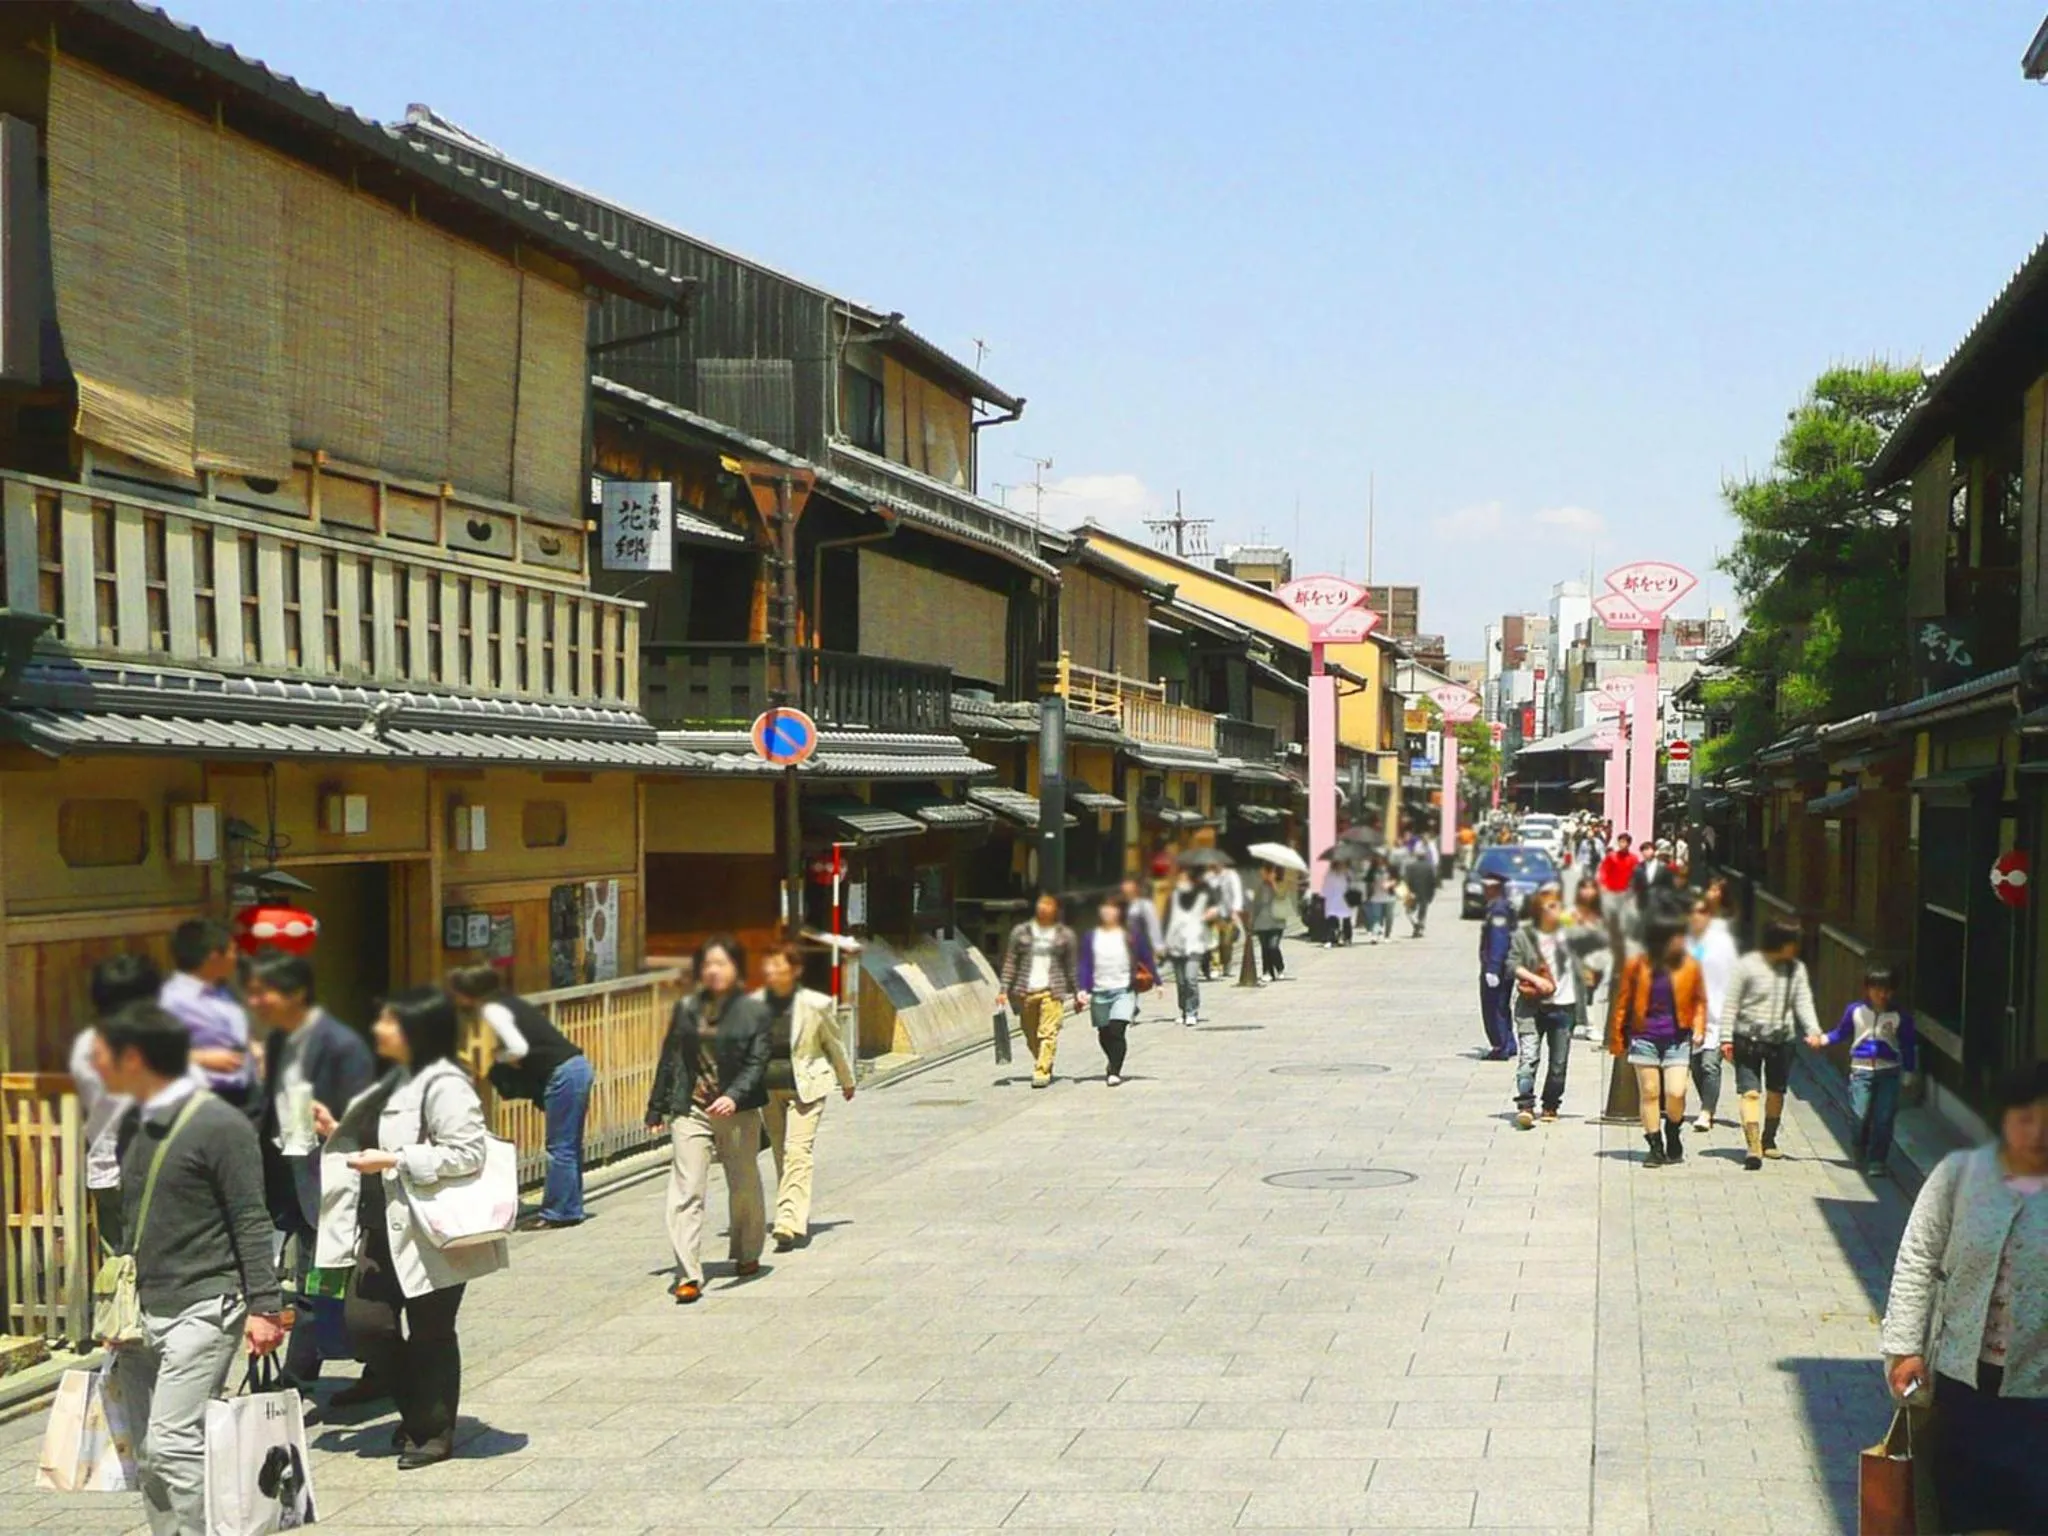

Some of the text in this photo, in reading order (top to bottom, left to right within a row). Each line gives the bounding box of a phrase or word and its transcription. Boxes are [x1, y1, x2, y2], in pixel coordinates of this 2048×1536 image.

[1623, 574, 1679, 595] 都をどり
[1294, 588, 1349, 608] 都をどり
